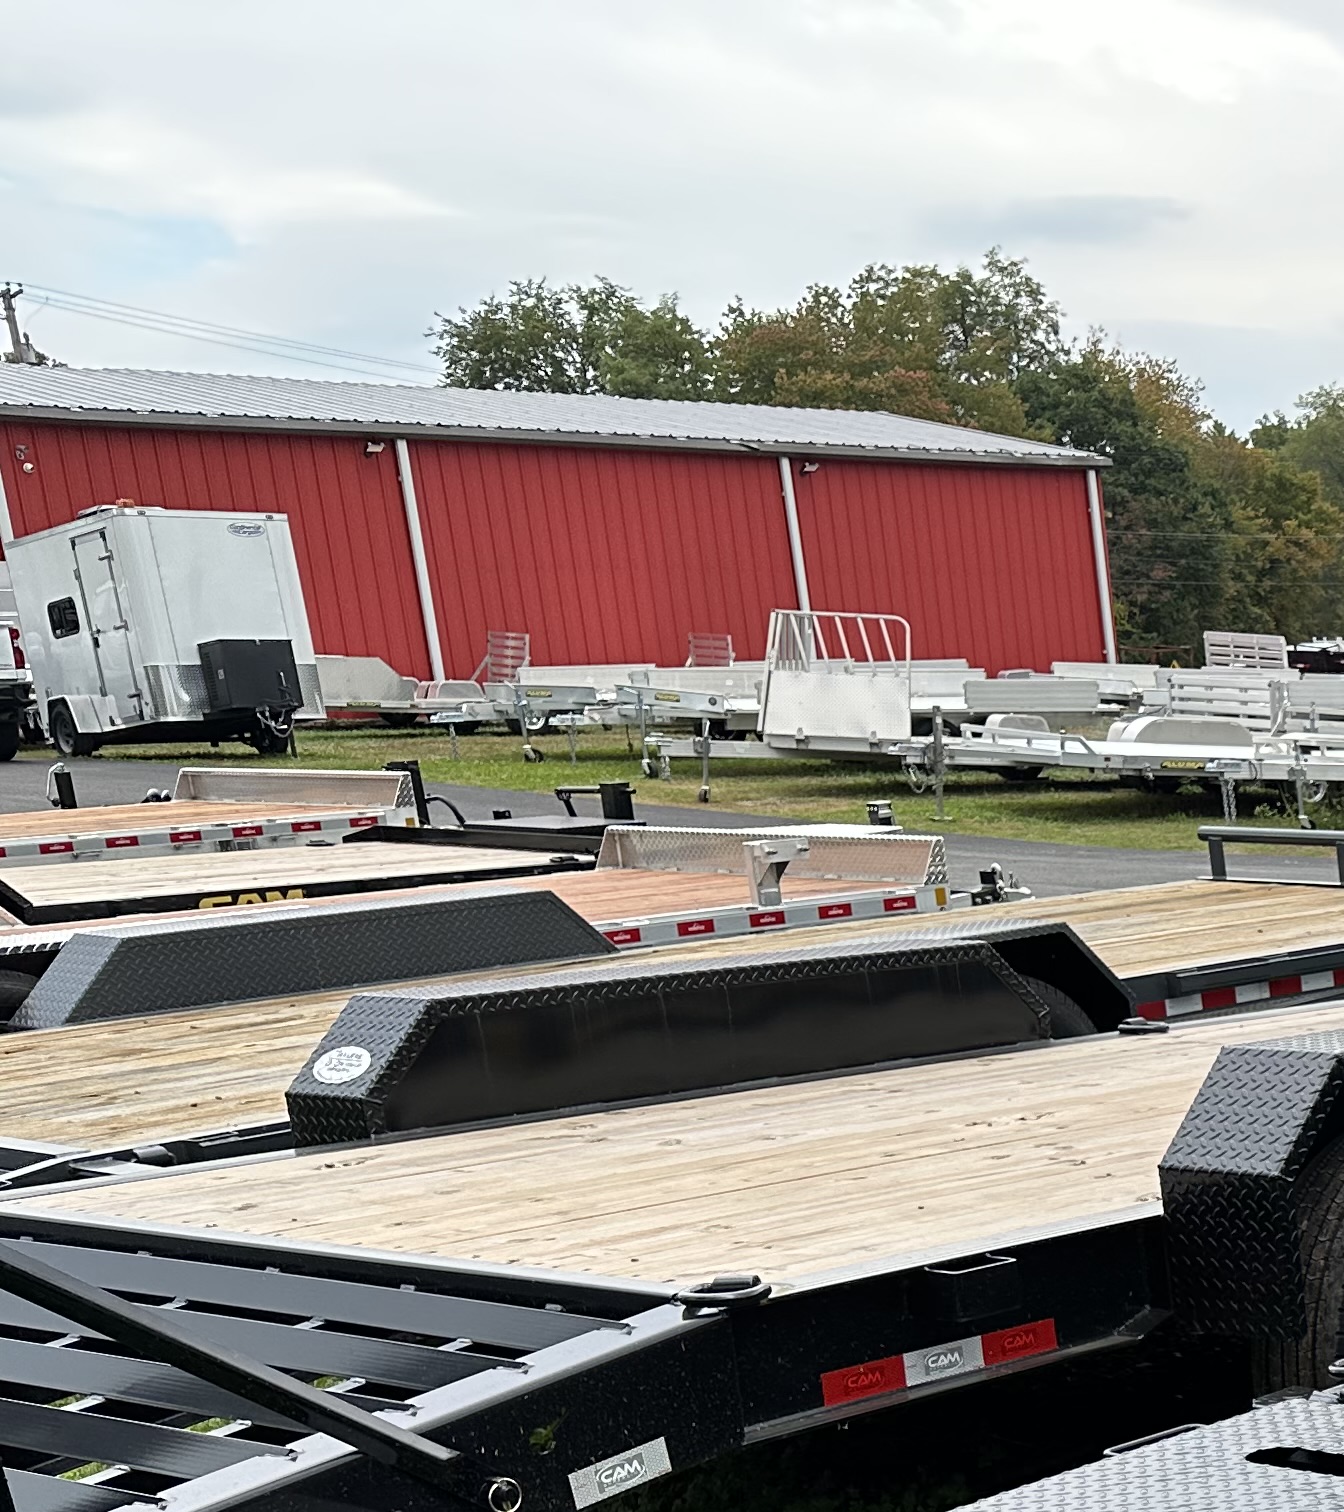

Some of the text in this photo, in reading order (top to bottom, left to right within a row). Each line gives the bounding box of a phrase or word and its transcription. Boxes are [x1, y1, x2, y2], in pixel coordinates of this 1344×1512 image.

[1003, 1333, 1035, 1350] CAM
[928, 1350, 961, 1368] CAM
[847, 1371, 882, 1388] CAM
[601, 1459, 642, 1484] CAM
